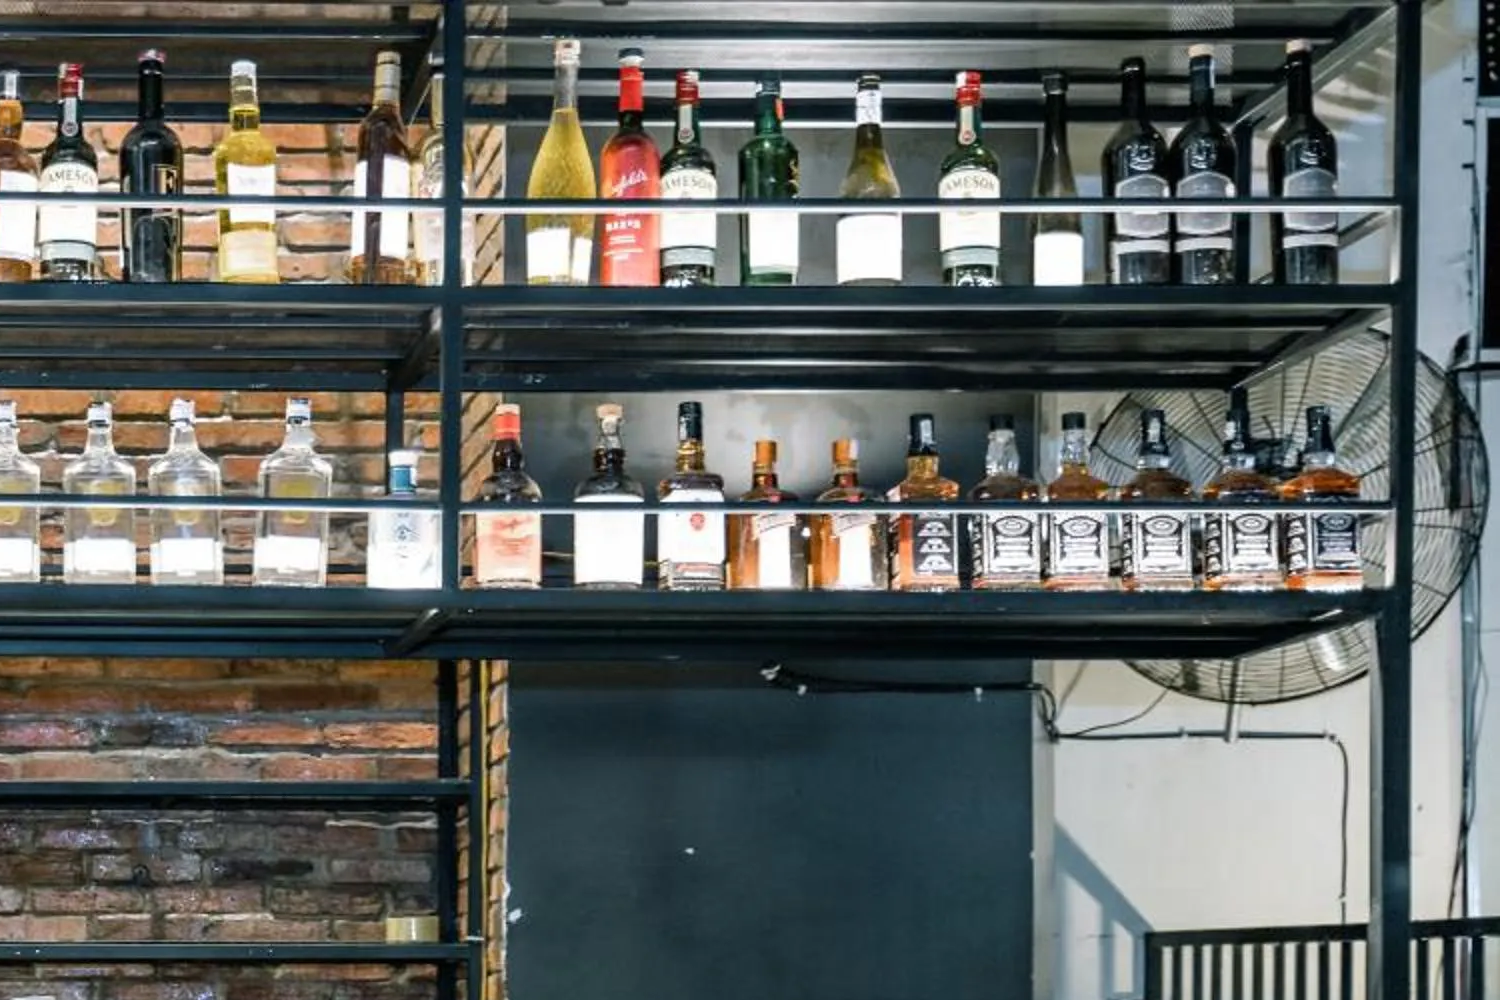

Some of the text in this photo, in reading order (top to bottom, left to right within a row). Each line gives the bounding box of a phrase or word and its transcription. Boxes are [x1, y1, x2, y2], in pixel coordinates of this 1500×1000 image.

[43, 168, 95, 187] AMESON
[662, 174, 713, 193] AMESON
[943, 175, 995, 194] AMESON
